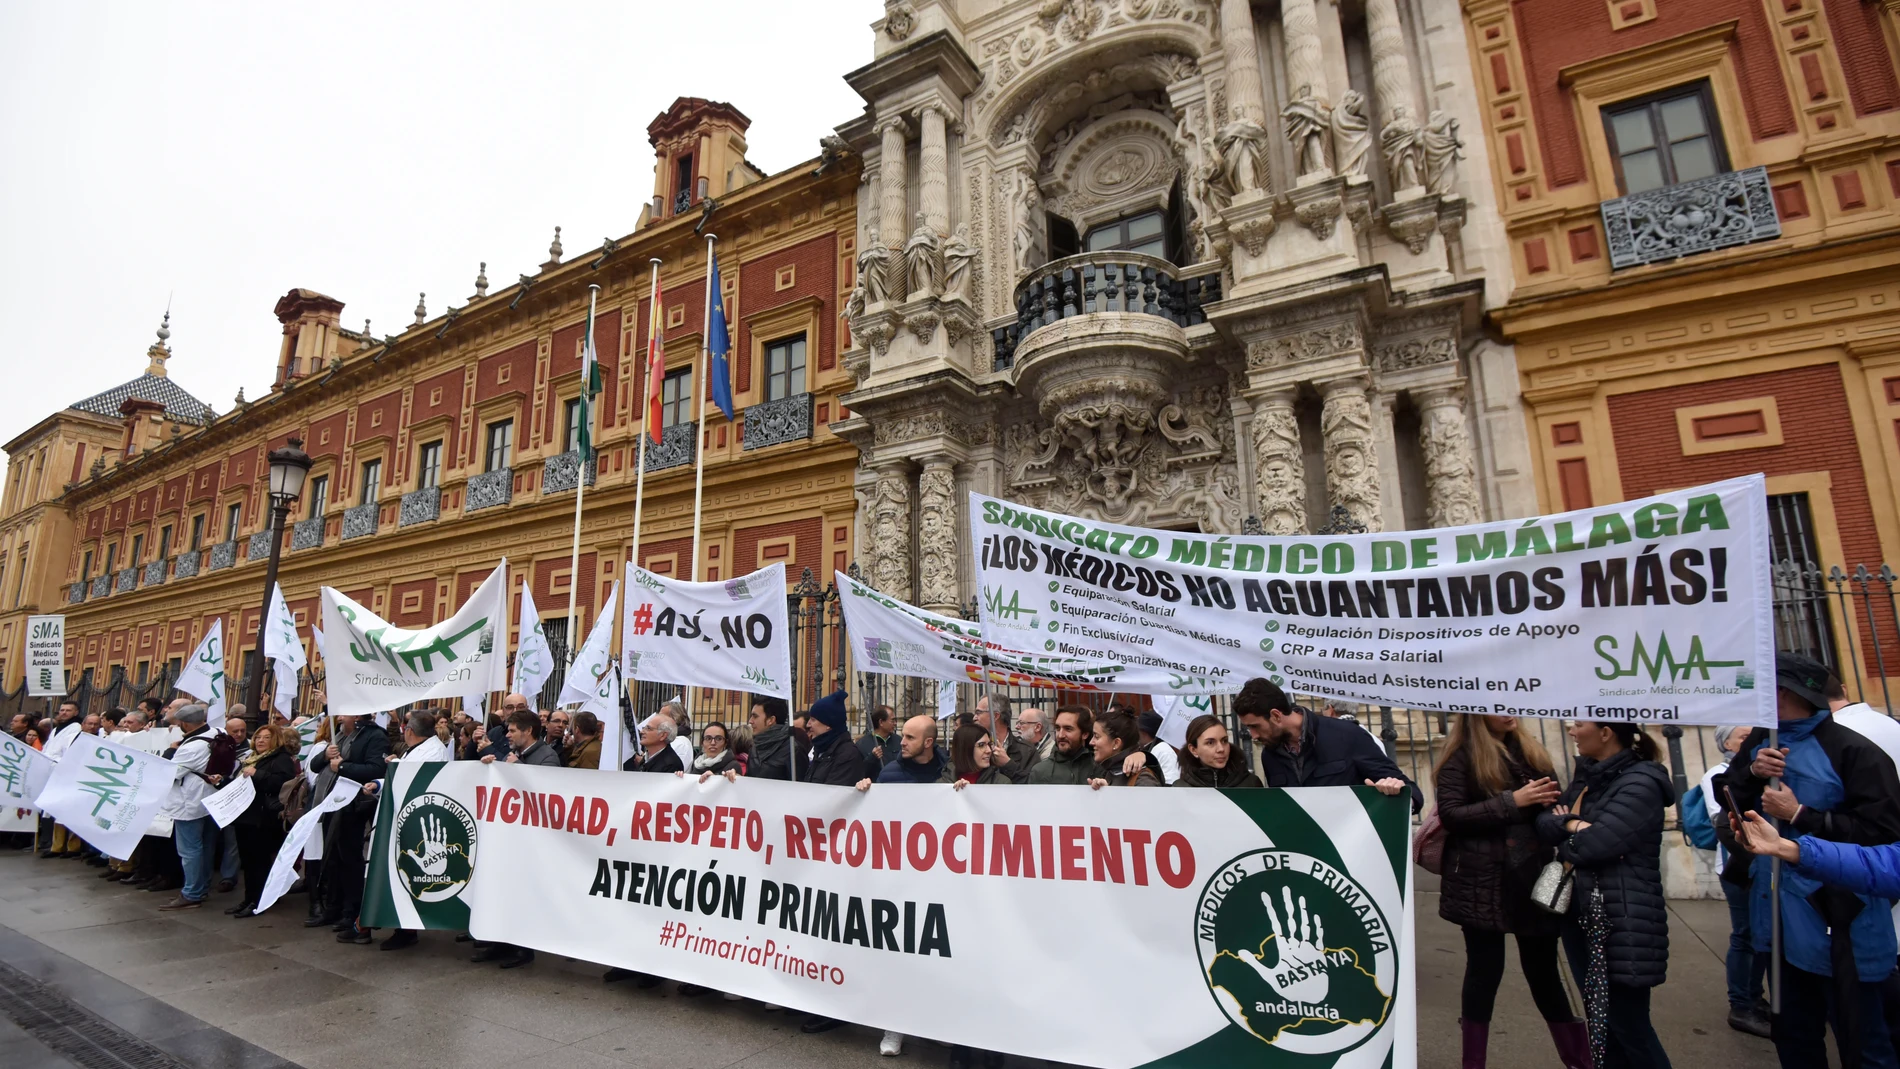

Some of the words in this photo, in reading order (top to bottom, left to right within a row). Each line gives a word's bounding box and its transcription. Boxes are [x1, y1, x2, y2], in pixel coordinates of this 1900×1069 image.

[982, 501, 1159, 559] SINDICATO
[1166, 537, 1355, 574] MÉDICO
[1371, 537, 1438, 572] DE
[1456, 493, 1730, 564] MÁLAGA
[982, 534, 1038, 572] ¡LOS
[1041, 547, 1181, 602] MÉDICOS
[1181, 574, 1236, 609] NO
[1242, 567, 1565, 618] AGUANTAMOS
[1581, 544, 1728, 607] MÁS!
[1063, 585, 1130, 608] Equiparación
[1131, 601, 1175, 617] Salarial
[32, 622, 60, 639] SMA
[721, 613, 772, 649] NO
[1062, 603, 1136, 625] Equiparación
[1140, 617, 1188, 636] Guardias
[1189, 630, 1241, 648] Médicas
[1063, 623, 1079, 635] Fin
[1081, 626, 1154, 646] Exclusividad
[1286, 623, 1373, 640] Regulación
[1378, 628, 1482, 642] Dispositivos
[1488, 623, 1511, 636] de
[1515, 622, 1580, 638] Apoyo
[1059, 642, 1104, 658] Mejoras
[1107, 650, 1186, 672] Organizativas
[1190, 665, 1206, 674] en
[1210, 667, 1231, 676] AP
[1281, 643, 1315, 656] CRP
[1332, 648, 1374, 660] Masa
[1379, 650, 1443, 663] Salarial
[1594, 629, 1744, 684] SMA
[1283, 665, 1378, 685] Continuidad
[1382, 673, 1480, 690] Asistencial
[1486, 680, 1508, 691] en
[1514, 678, 1541, 692] AP
[1599, 688, 1646, 696] Sindicato
[1650, 685, 1690, 695] Médico
[1693, 686, 1740, 695] Andaluz
[1449, 703, 1487, 714] para
[1494, 704, 1577, 717] Personal
[1585, 705, 1679, 721] Temporal
[423, 796, 436, 805] DE
[442, 799, 475, 846] PRIMARIA
[476, 785, 617, 846] DIGNIDAD,
[630, 801, 773, 865] RESPETO,
[784, 815, 1197, 889] RECONOCIMIENTO
[423, 852, 447, 868] BASTA
[446, 845, 459, 855] YA
[413, 874, 451, 883] andalucía
[588, 858, 746, 921] ATENCIÓN
[757, 879, 952, 958] PRIMARIA
[1200, 863, 1247, 942] MÉDICOS
[1262, 854, 1290, 870] DE
[1309, 861, 1389, 955] PRIMARIA
[659, 920, 845, 985] #PrimariaPrimero
[1275, 959, 1327, 989] BASTA
[1326, 950, 1352, 968] YA
[1255, 1000, 1339, 1020] andalucía
